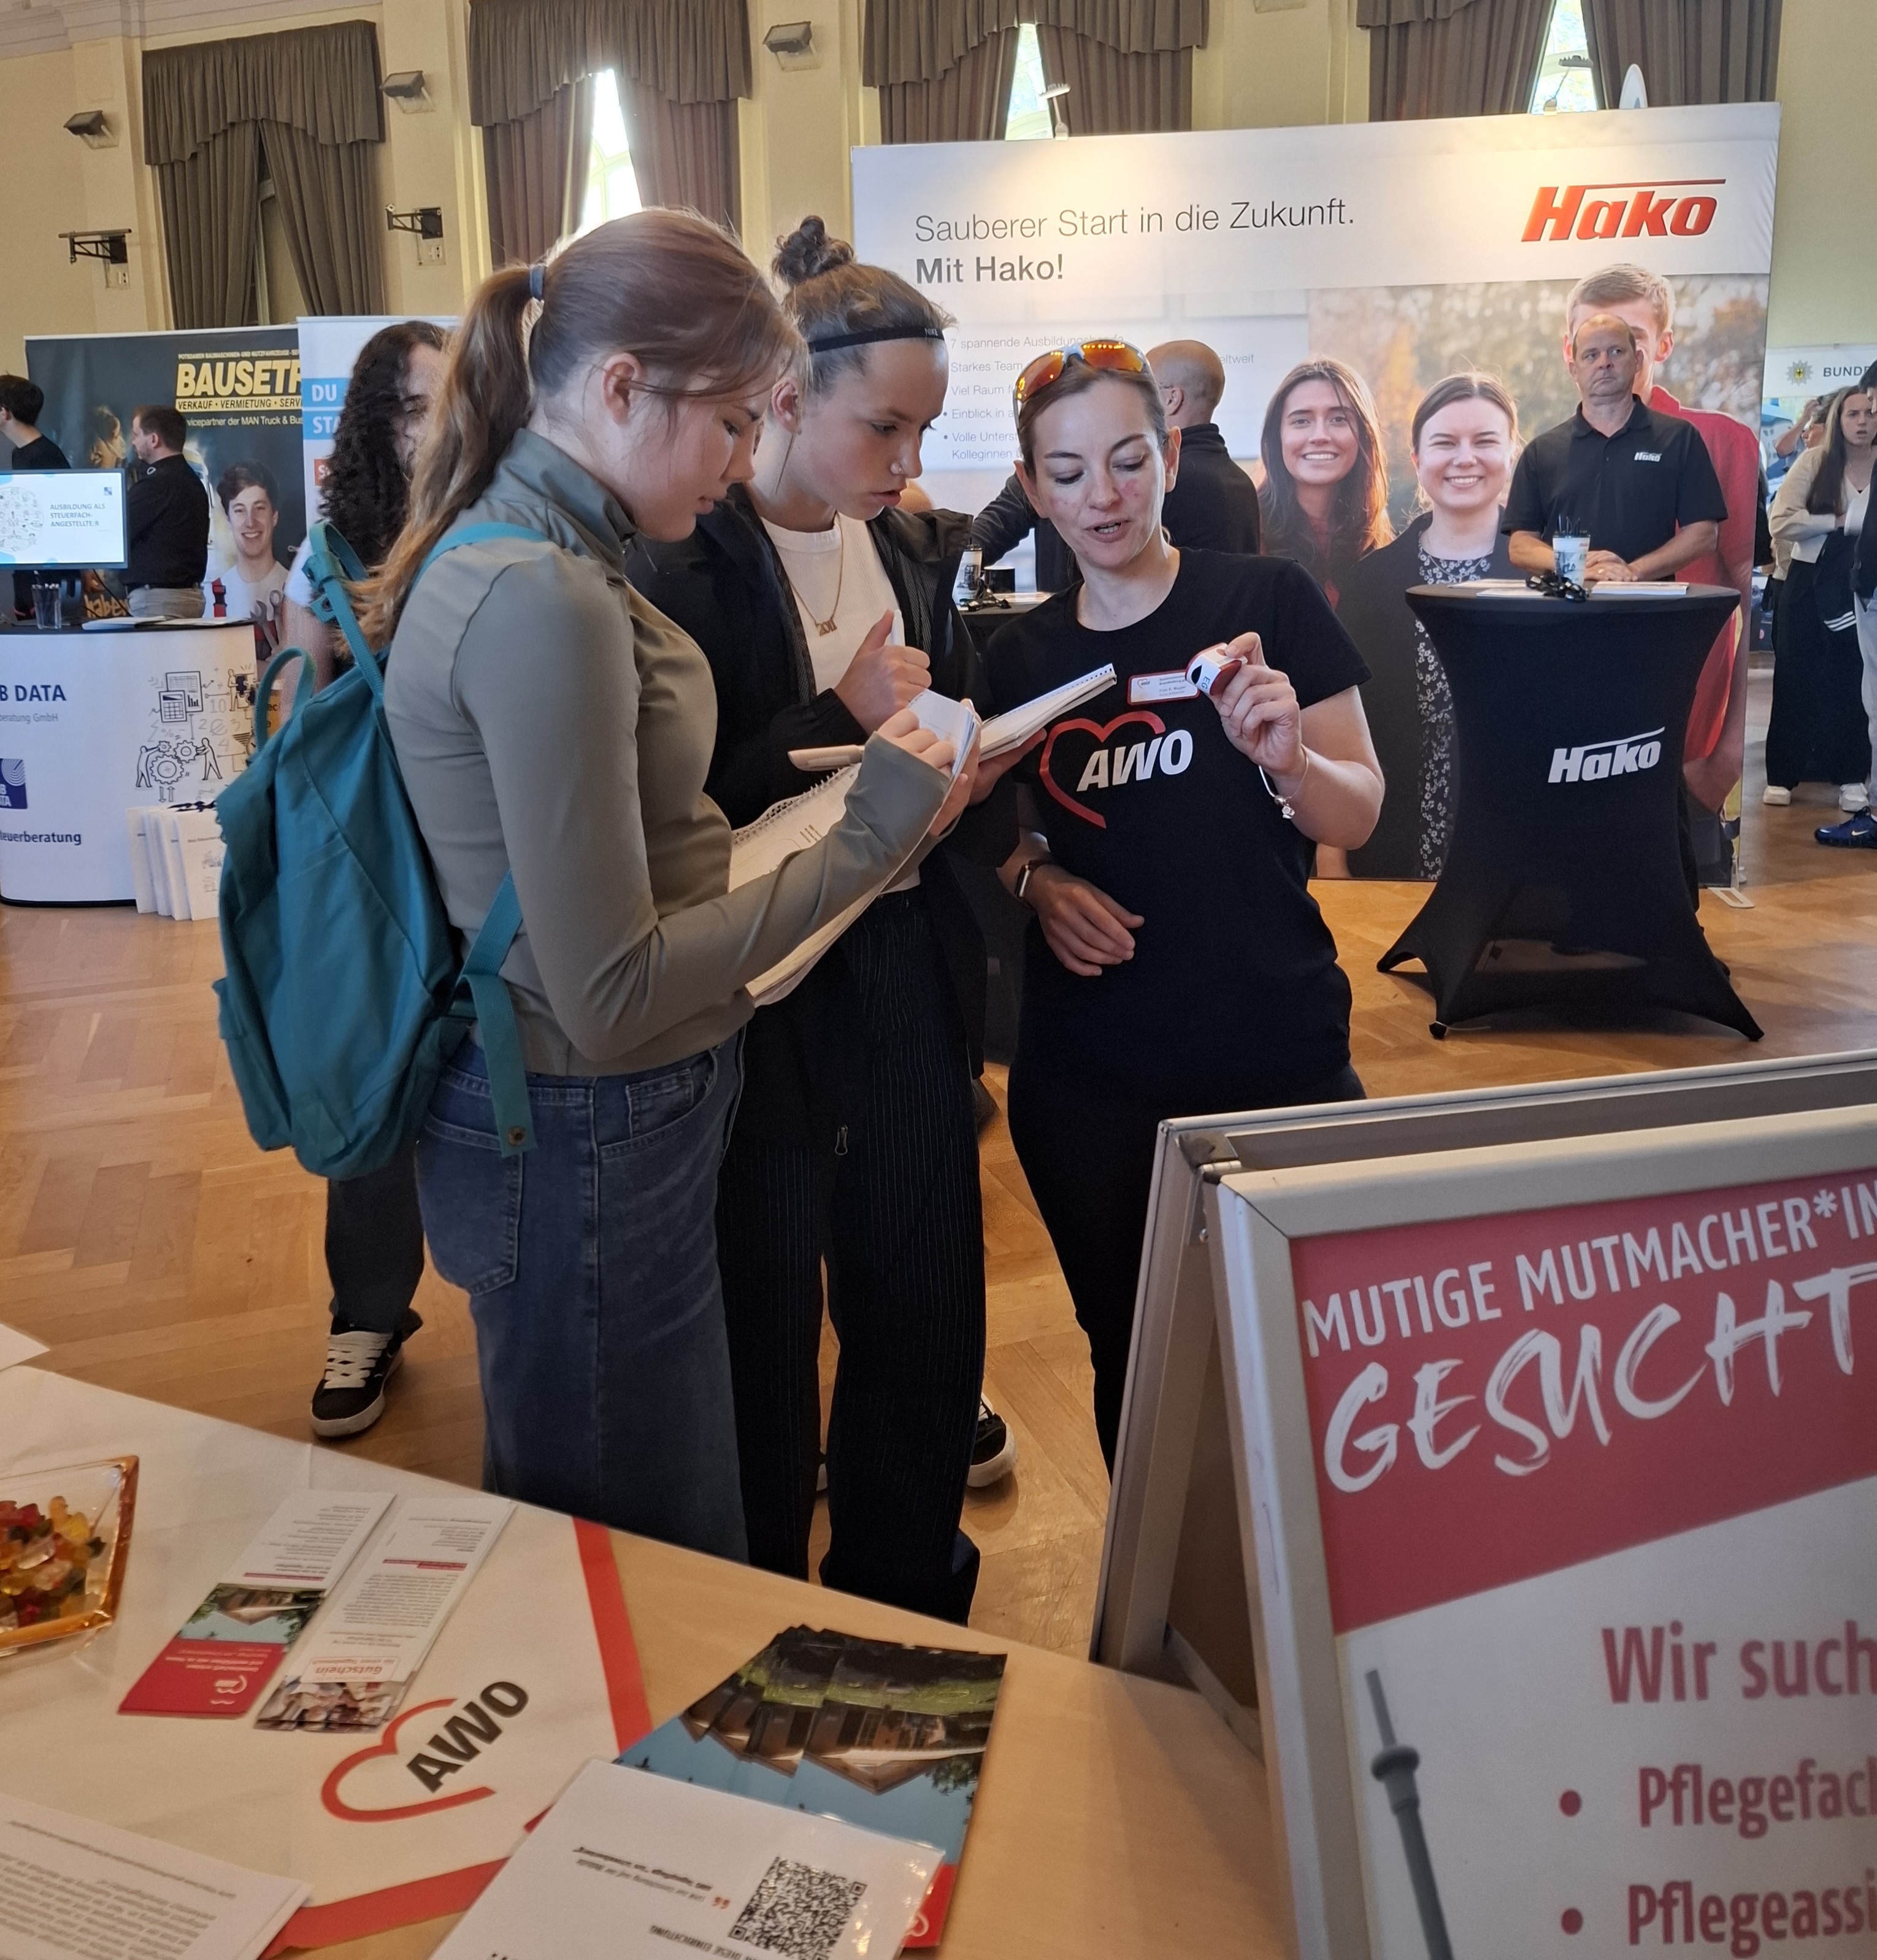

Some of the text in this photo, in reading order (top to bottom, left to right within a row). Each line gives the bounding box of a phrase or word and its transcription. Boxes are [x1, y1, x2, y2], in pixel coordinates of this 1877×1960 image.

[1521, 179, 1727, 242] Hako
[915, 198, 1354, 242] Sauberer Start in die Zukunft.
[916, 253, 1063, 284] Mit Hako!
[924, 328, 939, 337] NIKE
[951, 339, 956, 349] 7
[960, 337, 1020, 350] spannende
[1219, 353, 1254, 364] eltweit
[951, 360, 1023, 373] Starkes Team
[311, 383, 337, 402] DU
[951, 385, 970, 396] Viel
[973, 385, 1005, 395] Raum
[178, 400, 213, 410] VERKAUF
[221, 399, 272, 409] VERMIETUNG
[952, 408, 992, 419] Einblick
[996, 408, 1004, 418] in
[187, 417, 226, 428] vicepartner
[228, 416, 239, 426] der
[241, 415, 259, 426] MAN
[260, 415, 281, 425] Truck
[282, 415, 288, 425] &
[952, 432, 977, 442] Volle
[952, 449, 1013, 461] Kolleginnen
[1633, 452, 1662, 463] Hako
[0, 684, 67, 702] B DATA
[33, 713, 59, 722] GmbH
[1076, 729, 1194, 792] AWO
[1547, 726, 1665, 783] Hako
[0, 783, 7, 795] B
[1302, 1261, 1503, 1358] MUTIGE
[1323, 1262, 1877, 1494] GESUCHT
[1601, 1620, 1717, 1705] Wir
[315, 1666, 383, 1675] Gutschein
[406, 1681, 529, 1794] AWO
